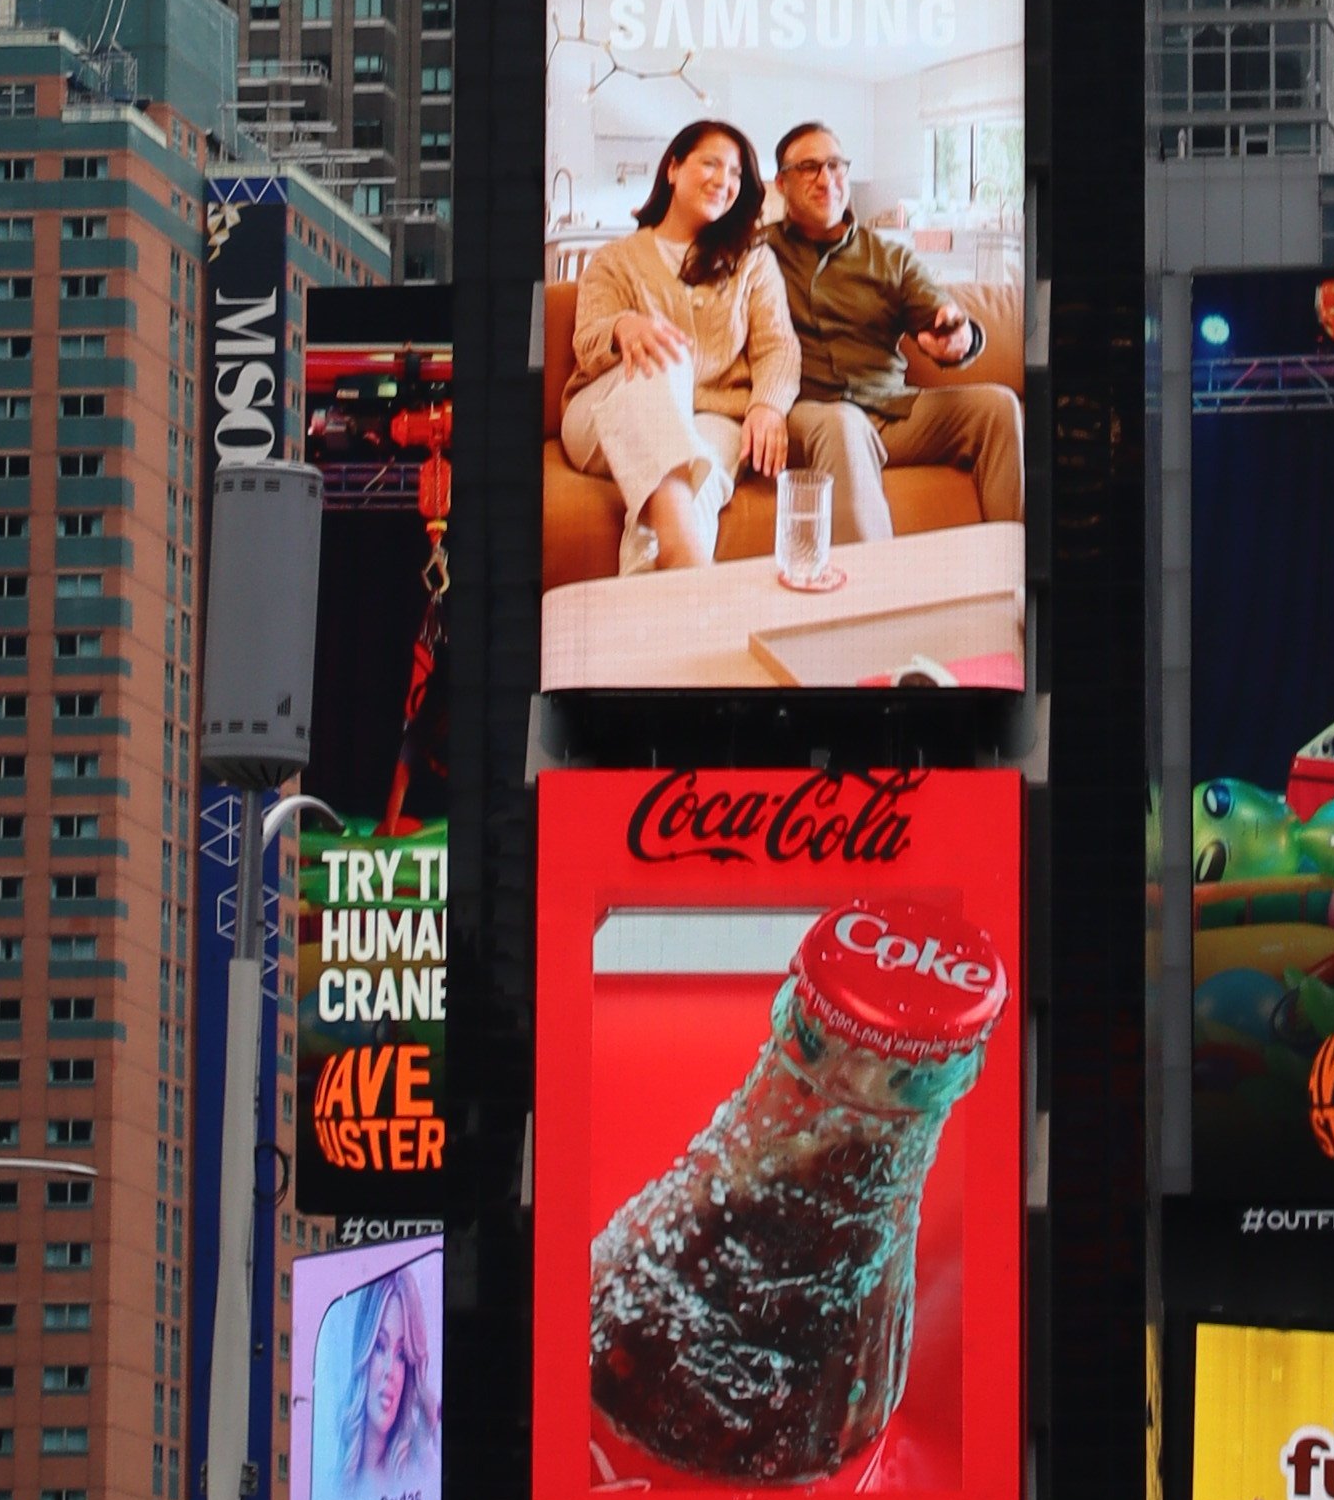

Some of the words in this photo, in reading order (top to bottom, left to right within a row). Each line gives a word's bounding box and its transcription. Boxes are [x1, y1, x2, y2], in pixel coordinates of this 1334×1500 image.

[626, 769, 929, 864] Coca-Cola
[322, 850, 402, 903] TRY
[835, 912, 992, 993] Coke
